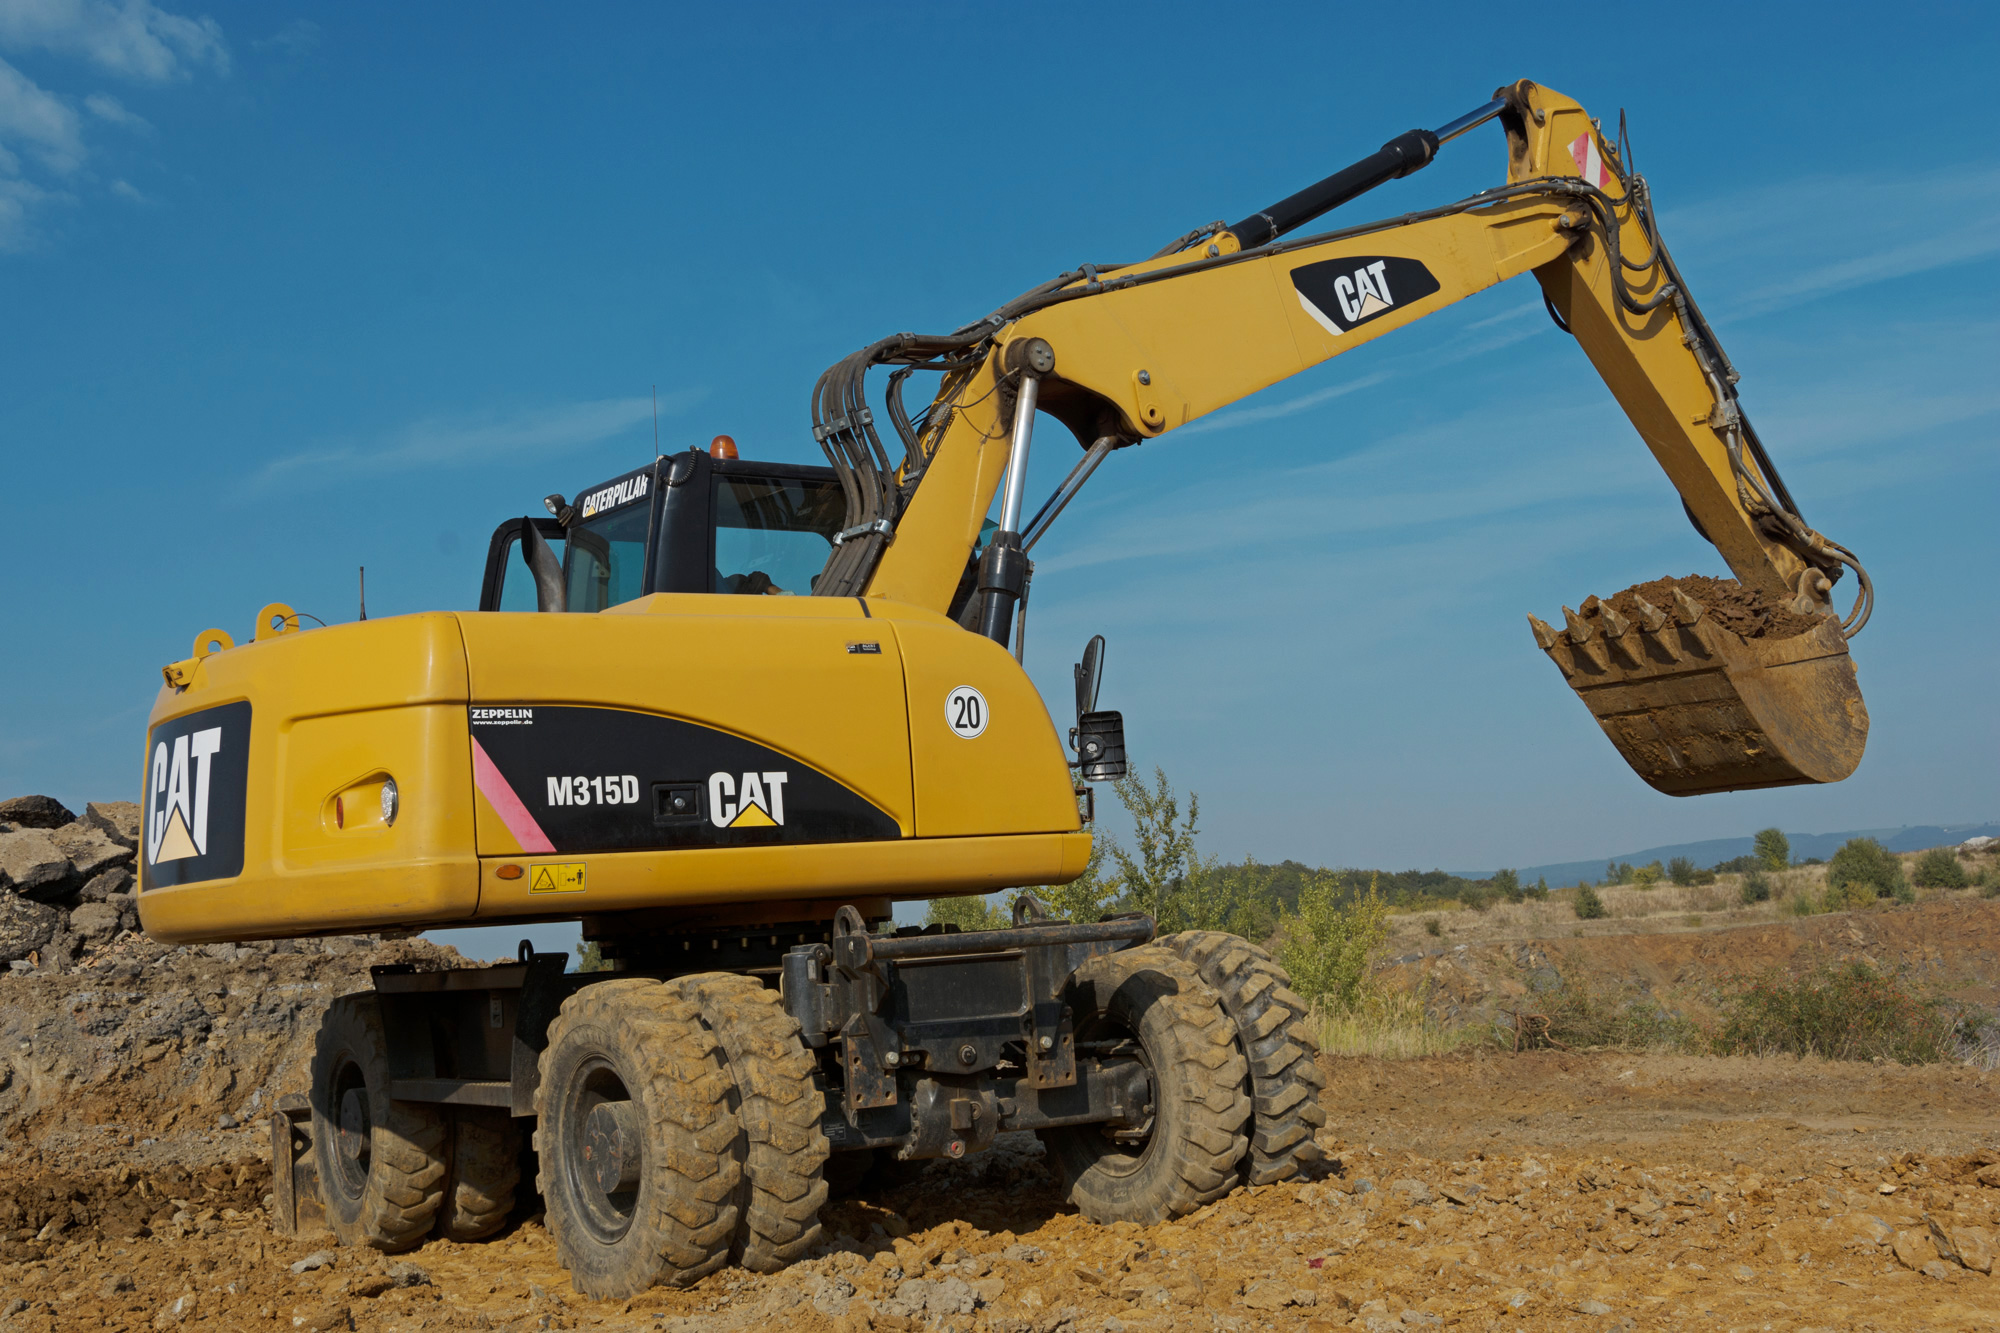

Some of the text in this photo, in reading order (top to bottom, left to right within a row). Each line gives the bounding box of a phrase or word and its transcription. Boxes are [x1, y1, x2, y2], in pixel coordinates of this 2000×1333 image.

[1334, 260, 1394, 322] CAT
[582, 473, 649, 518] CATERPILLAR
[472, 709, 533, 719] ZEPPELIN
[954, 696, 980, 729] 20
[148, 727, 222, 865] CAT
[547, 775, 640, 806] M315D
[709, 772, 788, 828] CAT
